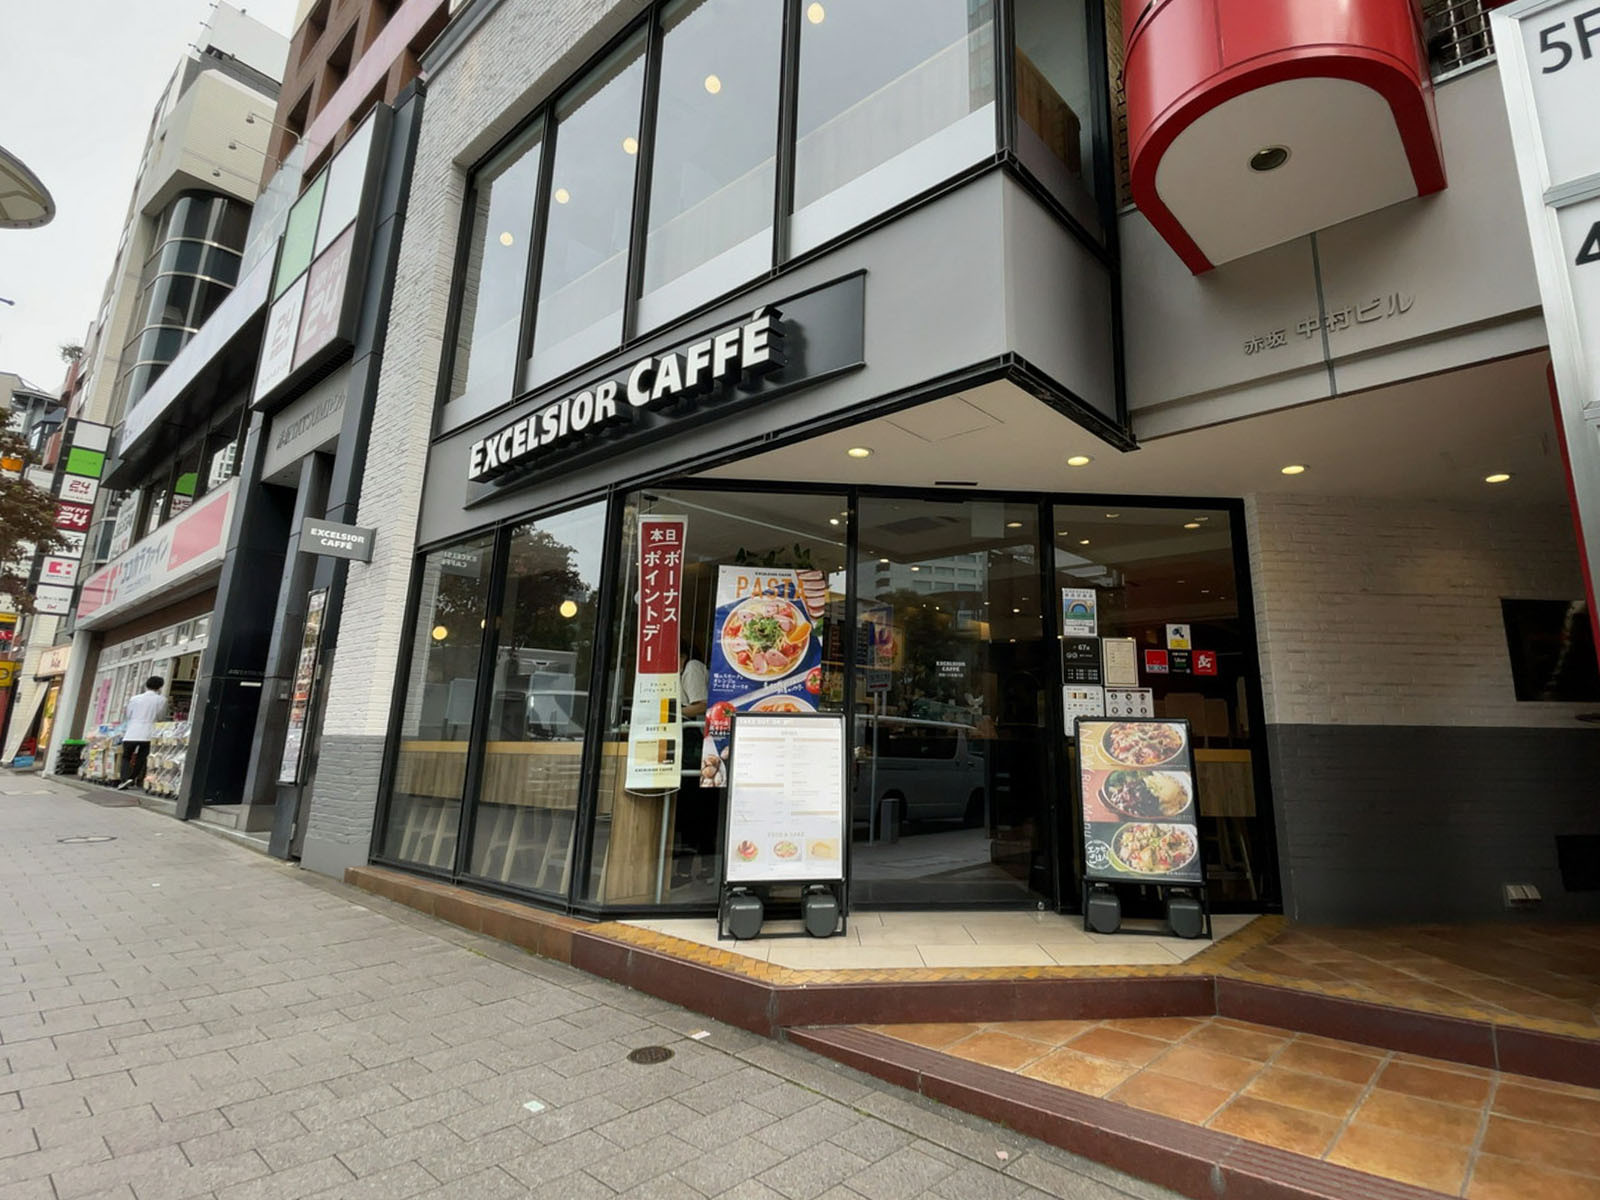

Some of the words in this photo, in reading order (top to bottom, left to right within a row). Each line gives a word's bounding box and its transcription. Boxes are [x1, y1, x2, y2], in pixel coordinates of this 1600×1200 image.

[1539, 7, 1600, 74] 5F
[1243, 328, 1288, 355] 赤坂
[1295, 292, 1416, 340] 中村ビル
[468, 379, 619, 481] EXCELSIOR
[626, 304, 774, 407] CAFFÉ
[55, 511, 88, 527] 24
[310, 527, 365, 544] EXCELSIOR
[650, 528, 677, 542] 本日
[642, 550, 661, 662] ポイントデー
[663, 549, 680, 623] ボーナス
[736, 575, 807, 602] PASTA
